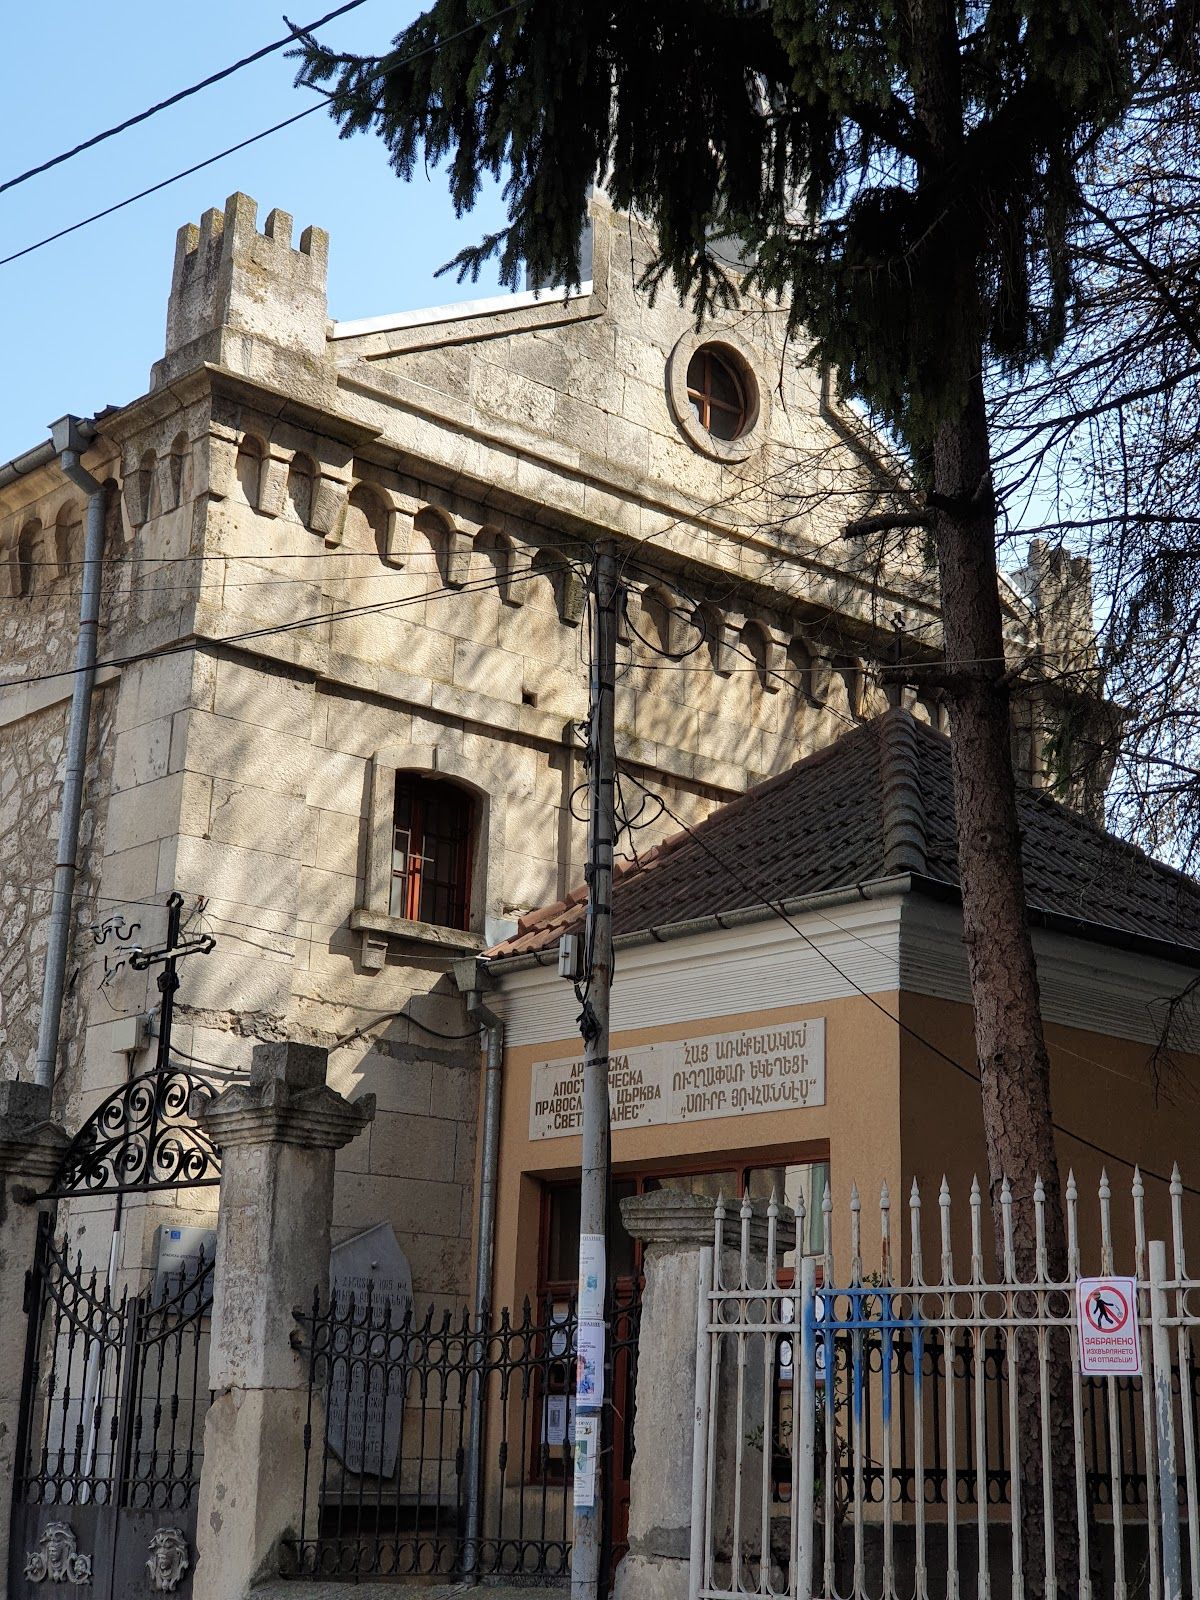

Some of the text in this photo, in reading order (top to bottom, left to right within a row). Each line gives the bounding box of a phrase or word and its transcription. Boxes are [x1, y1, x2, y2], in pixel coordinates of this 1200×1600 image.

[684, 1028, 807, 1067] ՀԱՅ ԱՌԱՔԵԼԱԿԱՆ
[570, 1055, 630, 1078] АРСКА
[672, 1054, 809, 1091] ՈՒՂՂԱՓԱՌ ԵԿԵՂԵՑԻ
[616, 1084, 662, 1105] ЦЪРКВА
[547, 1111, 585, 1131] „СВЕТ
[1085, 1337, 1133, 1345] ЗАБРАНЕНО
